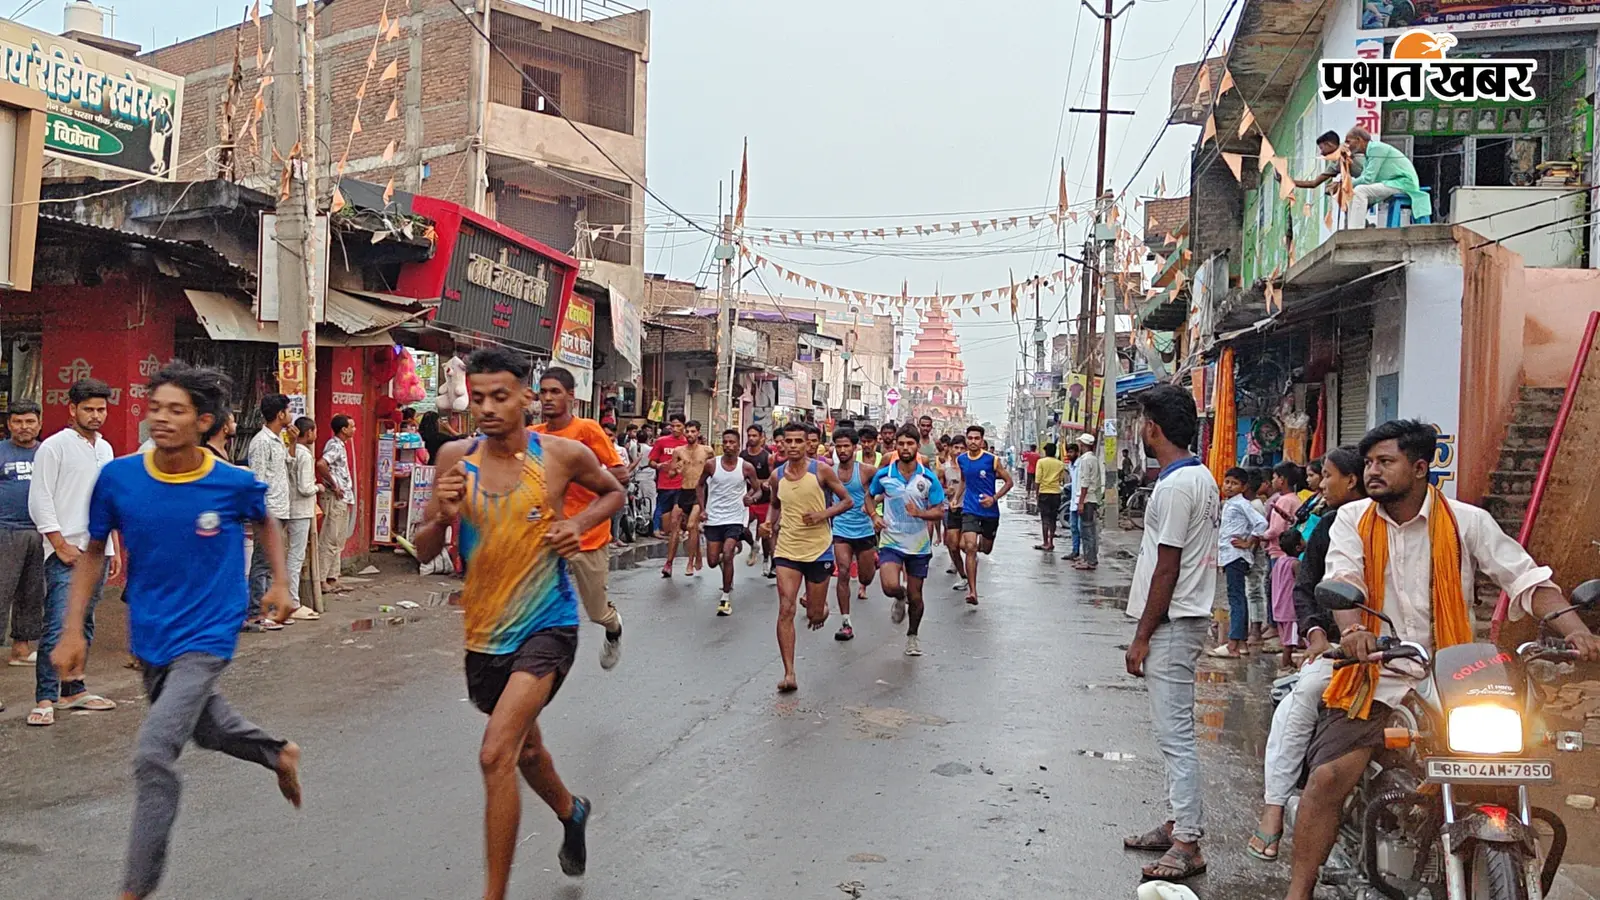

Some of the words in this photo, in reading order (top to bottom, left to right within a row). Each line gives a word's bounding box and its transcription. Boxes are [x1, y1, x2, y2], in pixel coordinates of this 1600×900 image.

[106, 69, 152, 122] स्टोर
[53, 119, 101, 151] विक्रेता
[58, 358, 93, 384] रवि
